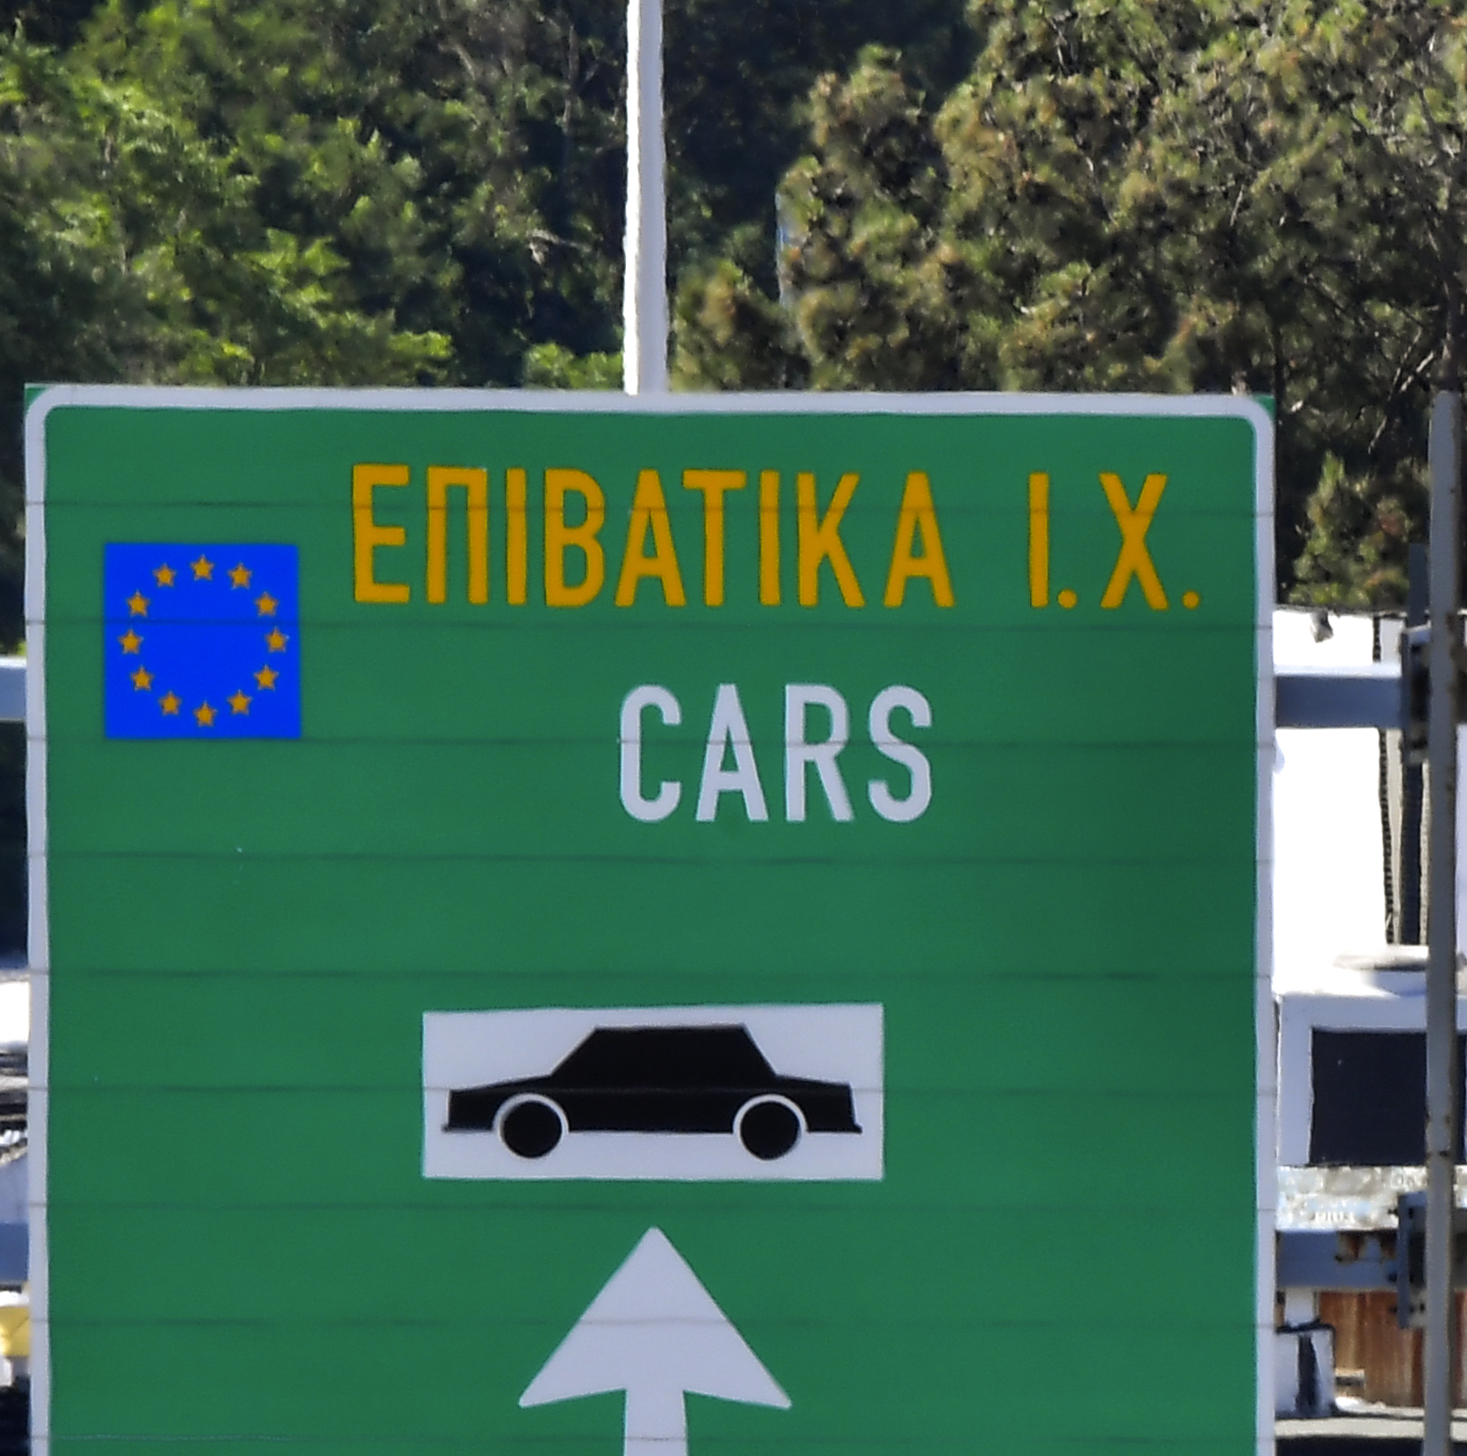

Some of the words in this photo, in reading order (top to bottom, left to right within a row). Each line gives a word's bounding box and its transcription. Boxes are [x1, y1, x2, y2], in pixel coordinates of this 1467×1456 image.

[351, 463, 956, 609] ΕΠΙΒΑΤΙΚΑ
[1027, 471, 1203, 611] Ι.Χ.
[618, 684, 934, 824] CARS
